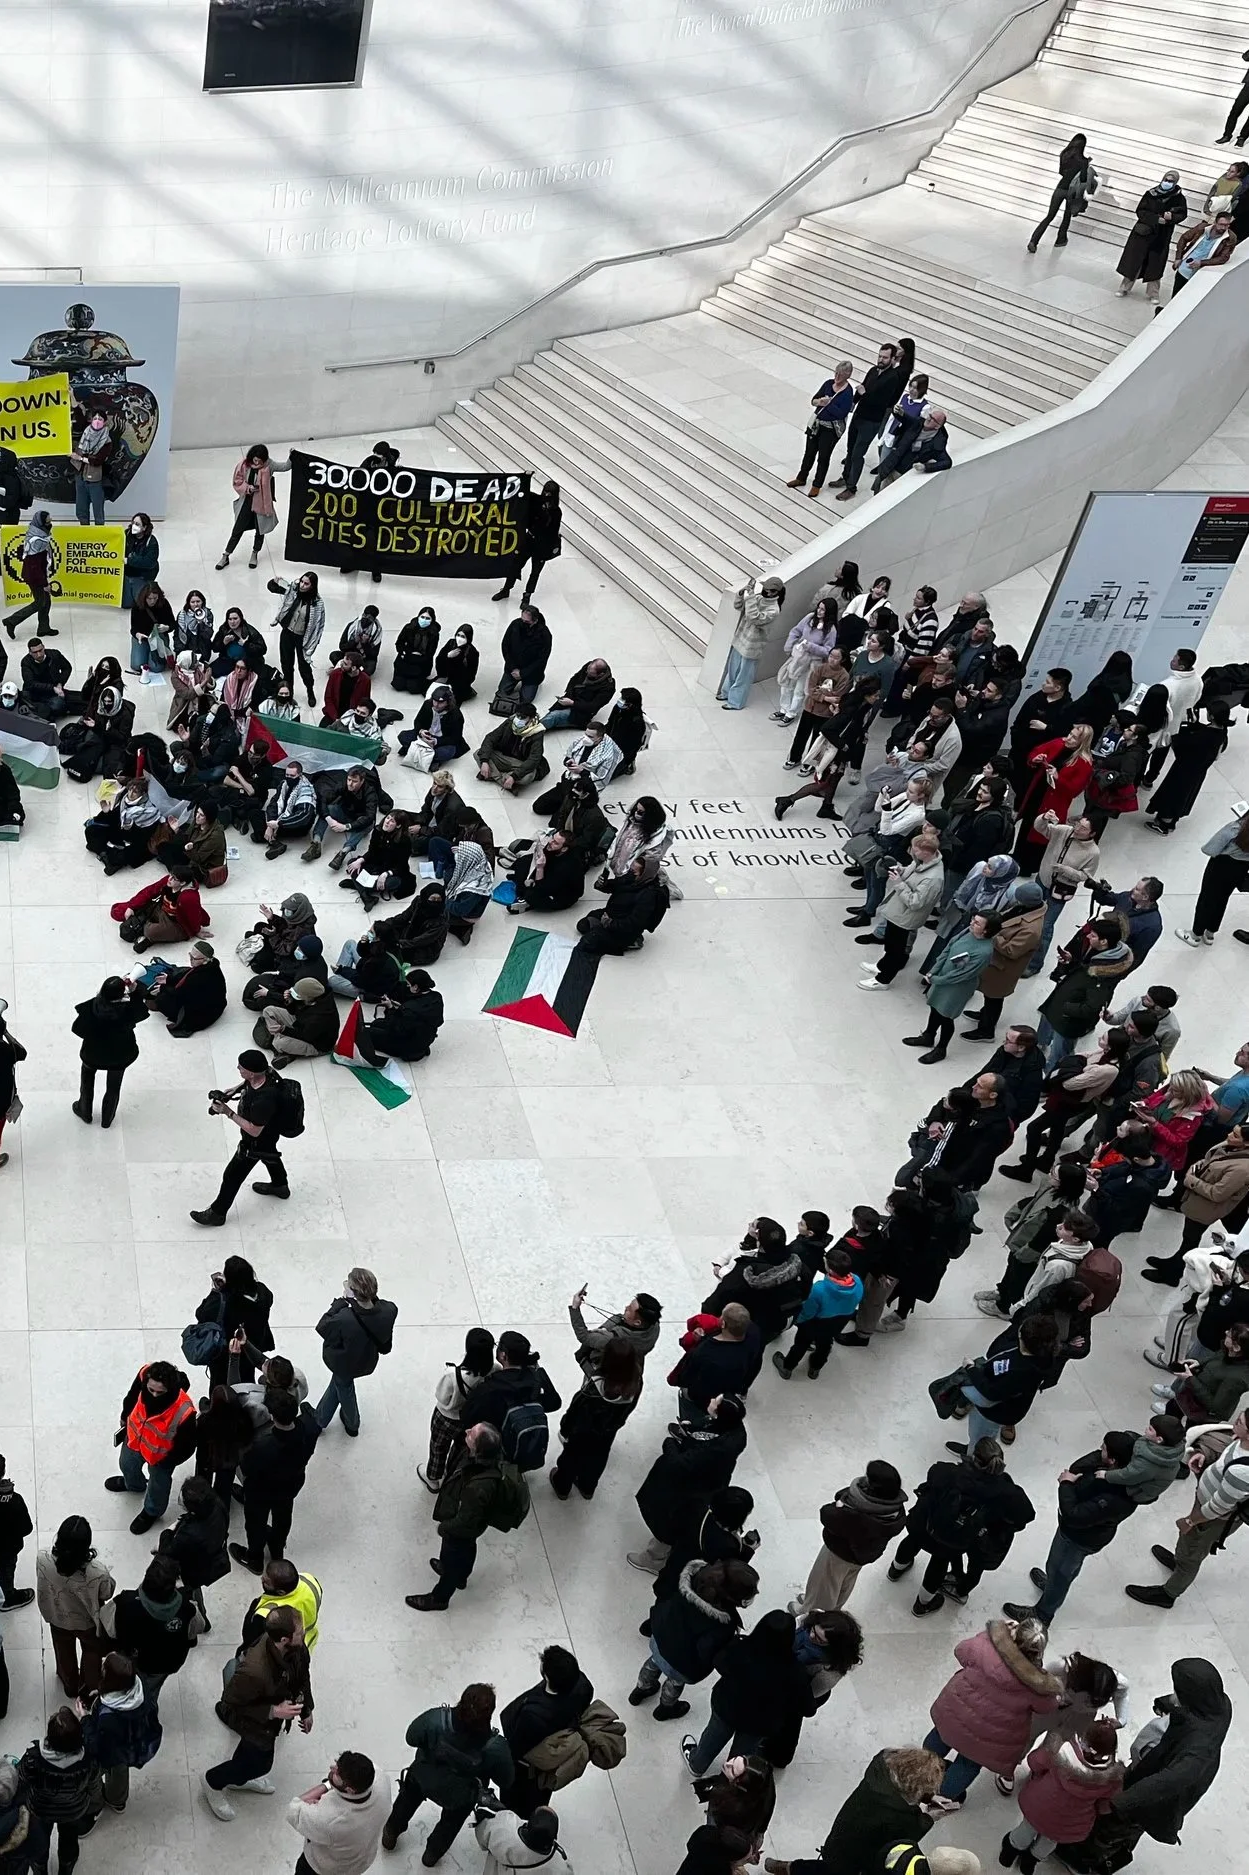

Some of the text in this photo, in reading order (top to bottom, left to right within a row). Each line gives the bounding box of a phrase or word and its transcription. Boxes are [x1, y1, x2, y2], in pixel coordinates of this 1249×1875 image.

[270, 156, 615, 209] The Millennium Commission
[267, 204, 537, 254] Heritage Lottery Fund
[22, 421, 57, 439] US.
[429, 475, 525, 503] DEAD.
[305, 488, 517, 527] 200 CULTURAL
[301, 516, 520, 557] SITES DESTROYED.
[66, 542, 108, 551] ENERGY
[66, 550, 118, 559] EMBARGO
[66, 566, 121, 576] PALESTINE
[6, 593, 17, 601] No
[602, 801, 629, 815] et
[689, 798, 747, 815] feet
[692, 850, 719, 867] of
[728, 849, 857, 867] knowled
